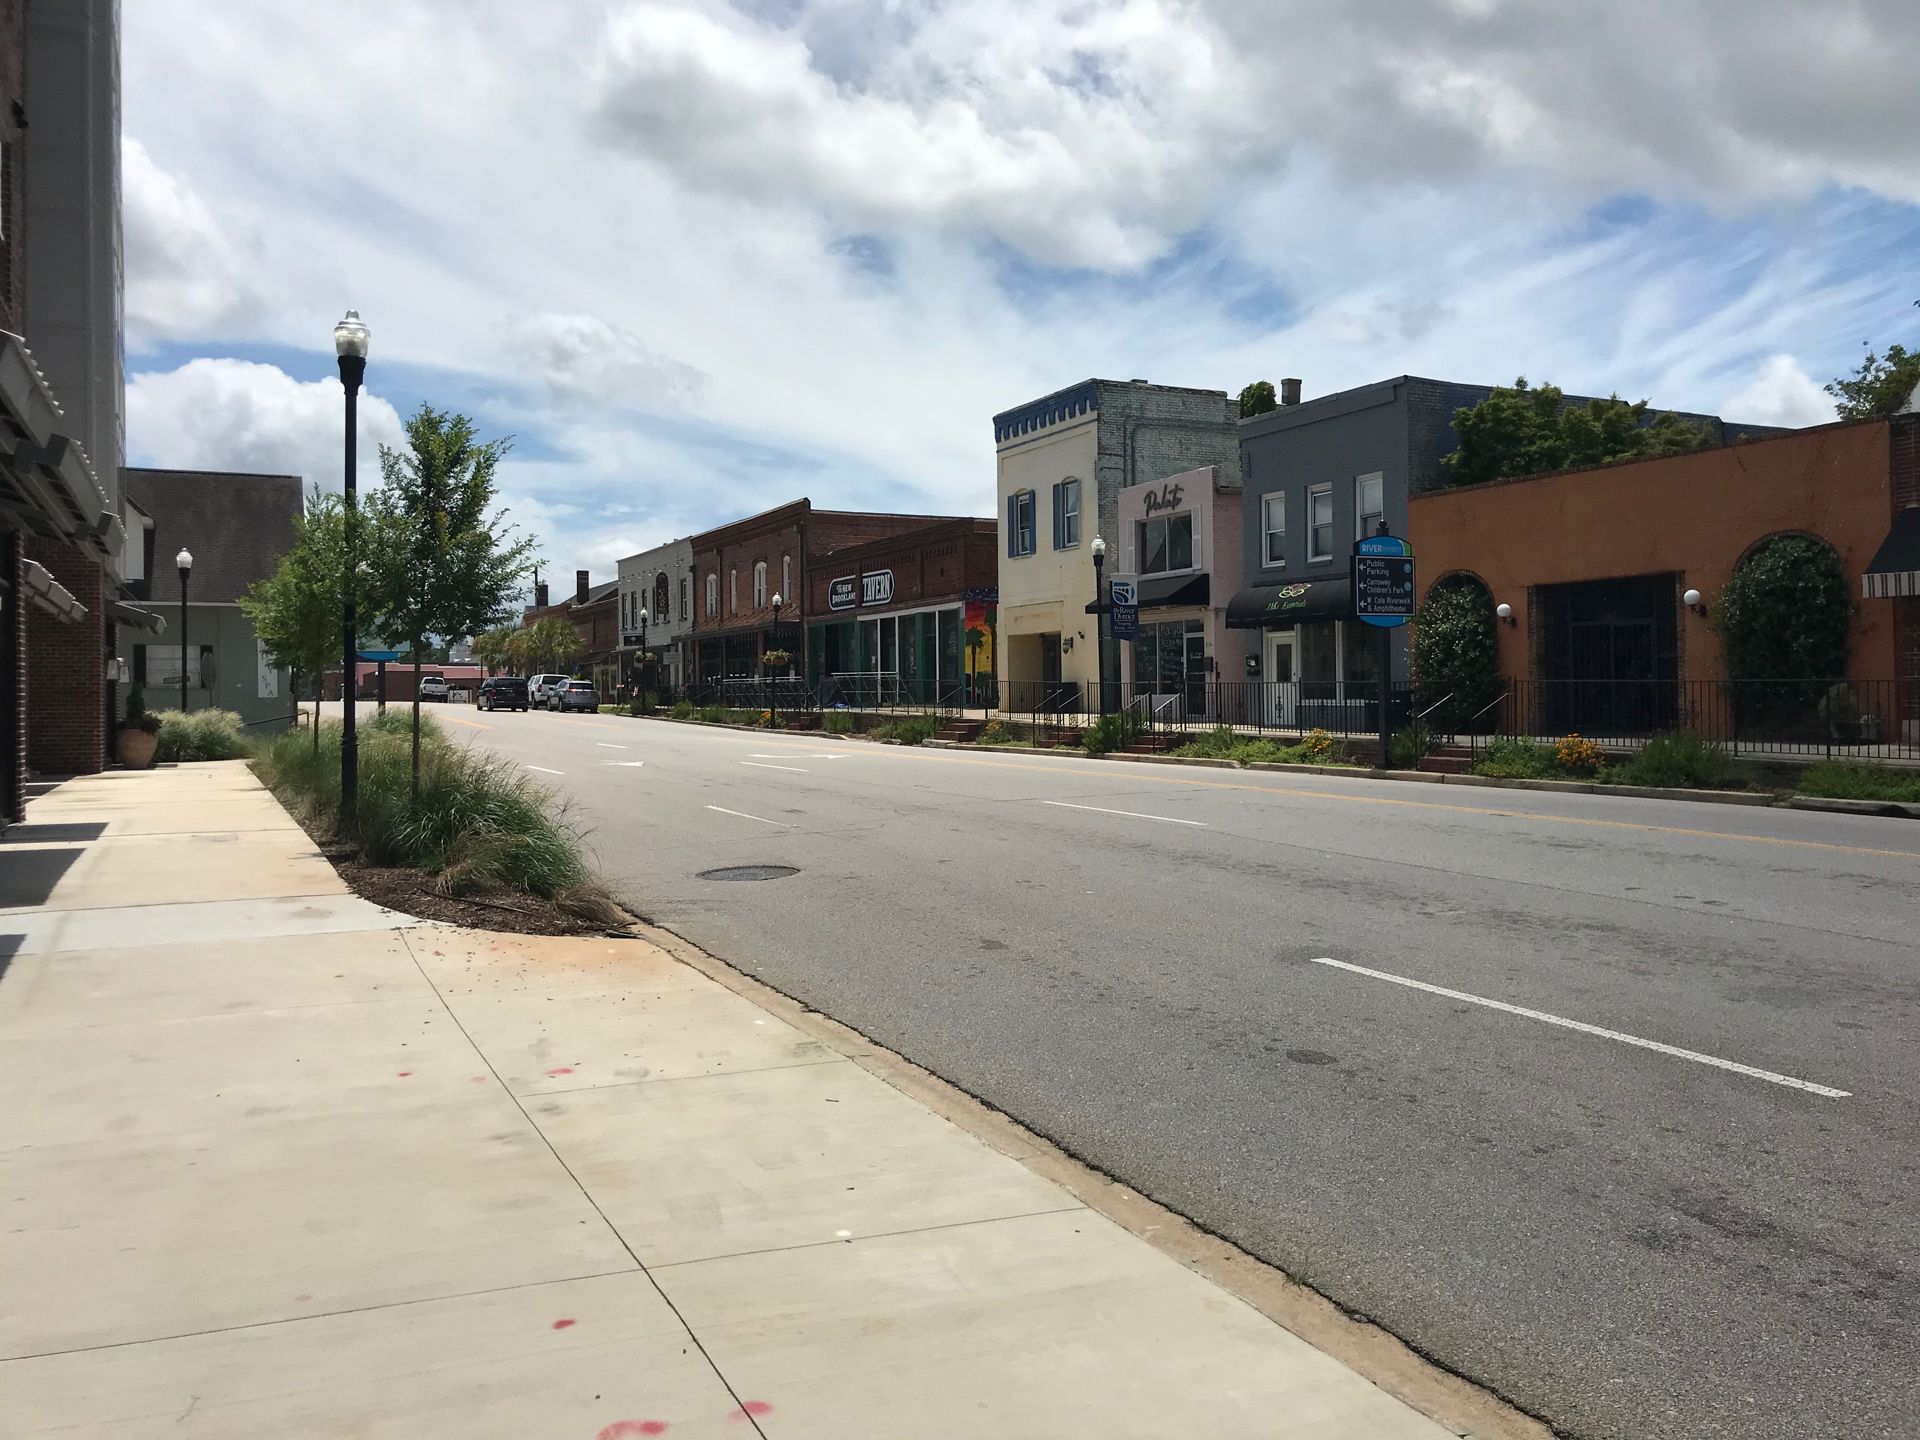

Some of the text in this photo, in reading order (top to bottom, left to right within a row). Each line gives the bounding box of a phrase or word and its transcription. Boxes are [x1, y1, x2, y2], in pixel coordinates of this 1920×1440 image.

[1143, 484, 1184, 517] Palate
[1361, 544, 1382, 553] RIVER
[1366, 560, 1385, 568] Public
[1366, 568, 1390, 577] Parking
[842, 584, 852, 593] NEW
[863, 574, 890, 601] TAVERN
[1392, 586, 1405, 594] Park
[1374, 596, 1386, 604] Cola
[1386, 597, 1411, 605] Riverwalk
[1120, 606, 1135, 614] River
[1113, 612, 1136, 620] District
